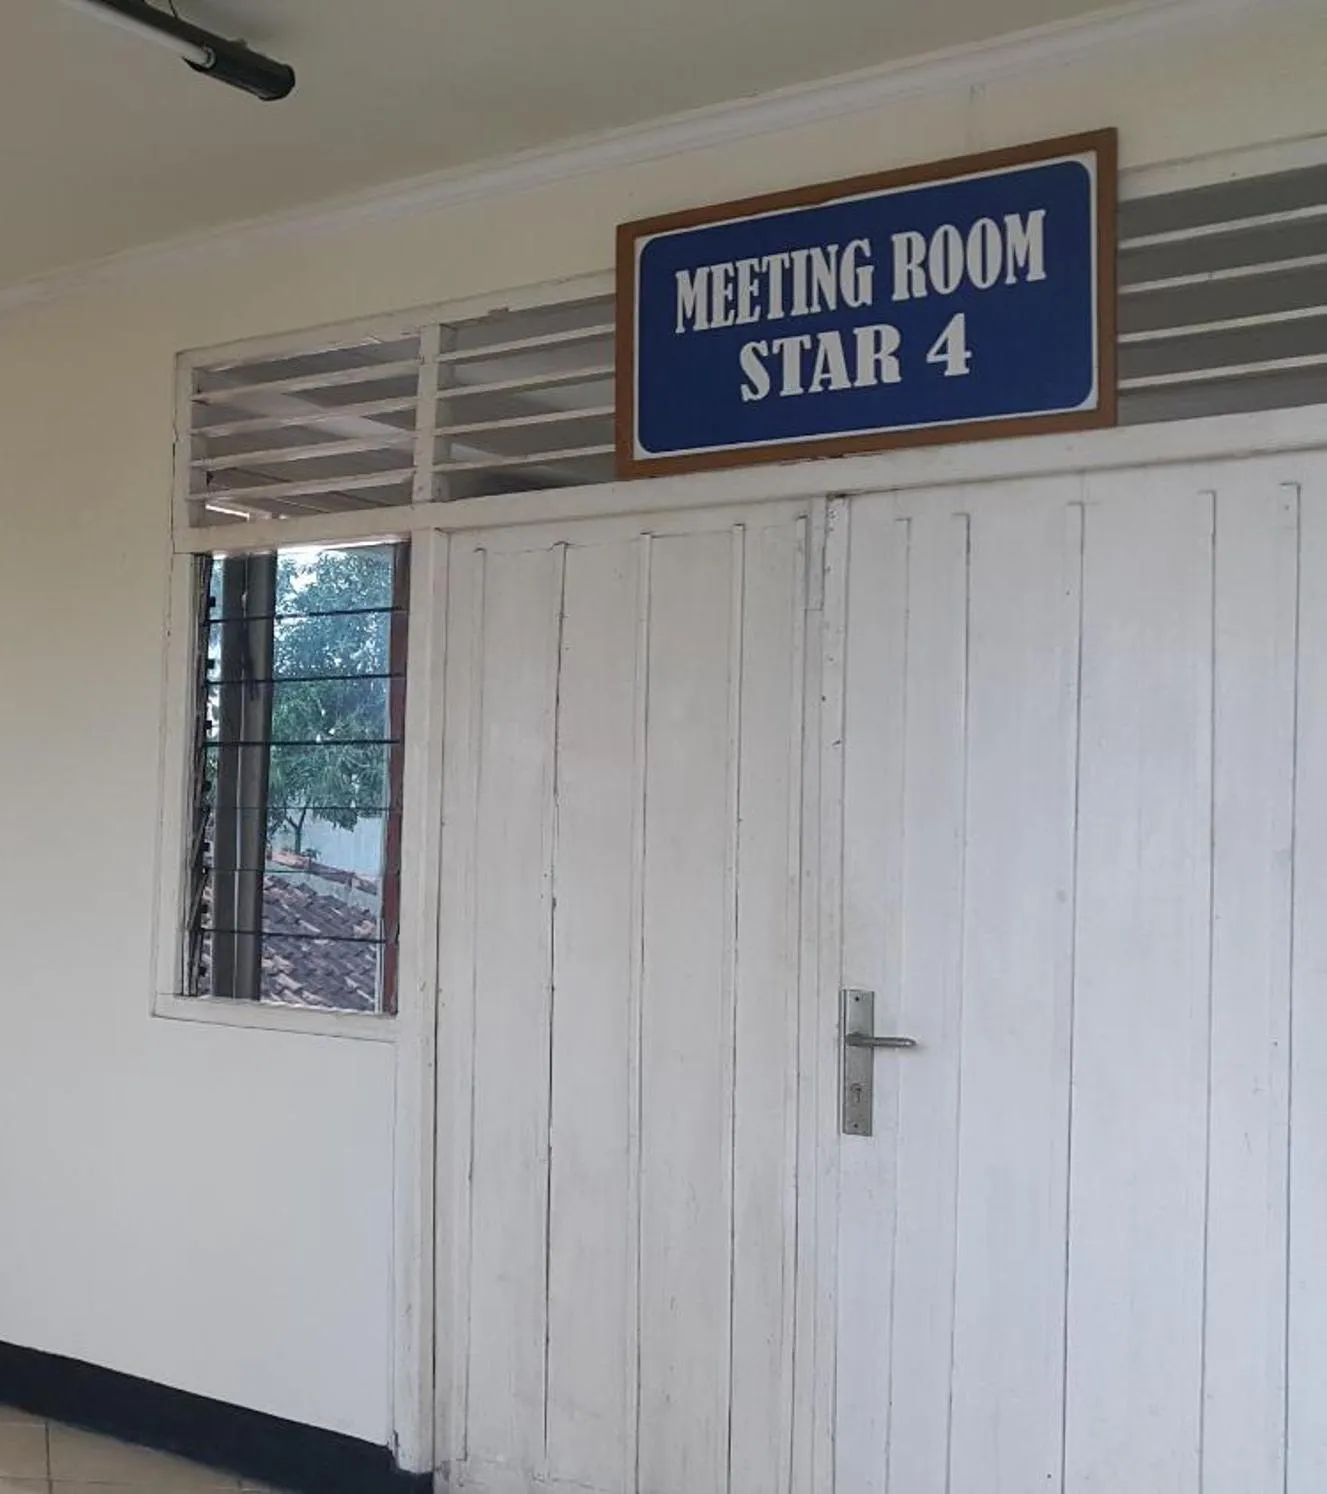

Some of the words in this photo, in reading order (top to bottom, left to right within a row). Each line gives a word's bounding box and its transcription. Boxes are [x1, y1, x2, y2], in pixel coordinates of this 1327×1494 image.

[675, 239, 873, 333] MEETING
[892, 210, 1046, 301] ROOM
[739, 324, 901, 401] STAR
[926, 313, 971, 376] 4
